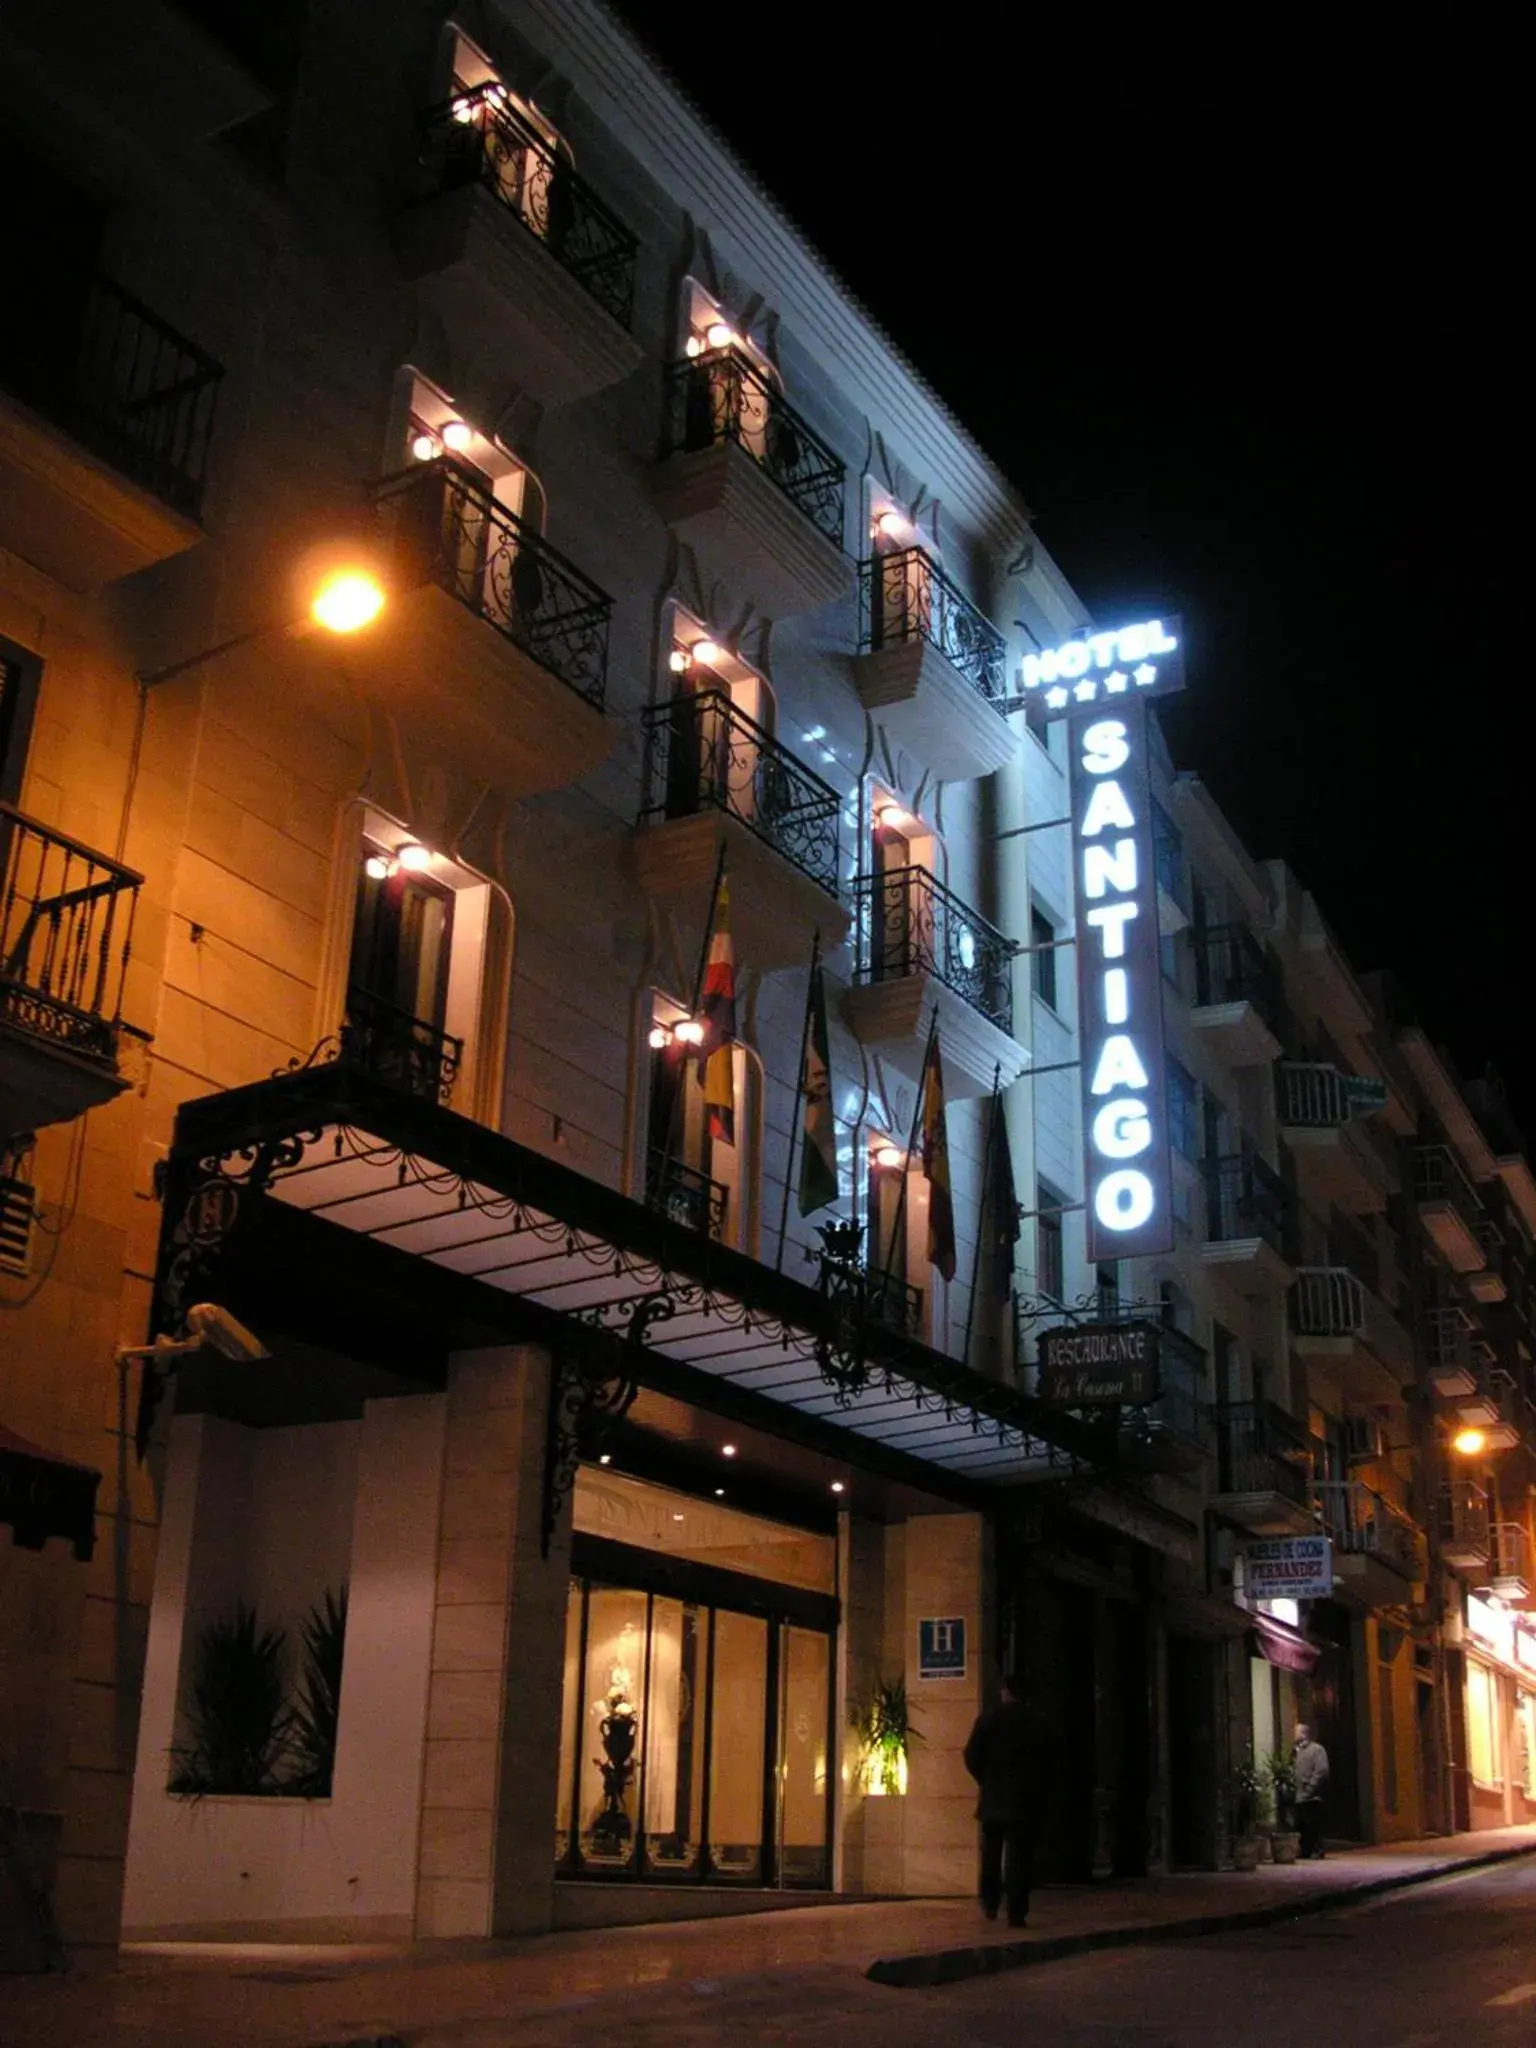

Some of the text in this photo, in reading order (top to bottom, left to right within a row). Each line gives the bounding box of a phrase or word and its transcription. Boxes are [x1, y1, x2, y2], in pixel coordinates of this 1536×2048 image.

[1022, 619, 1178, 688] HOTEL
[1081, 719, 1156, 1232] SANTIAGO
[1047, 1331, 1145, 1366] RESTAURANTE
[1251, 1560, 1323, 1579] FERNANDEZ
[928, 1622, 956, 1653] H
